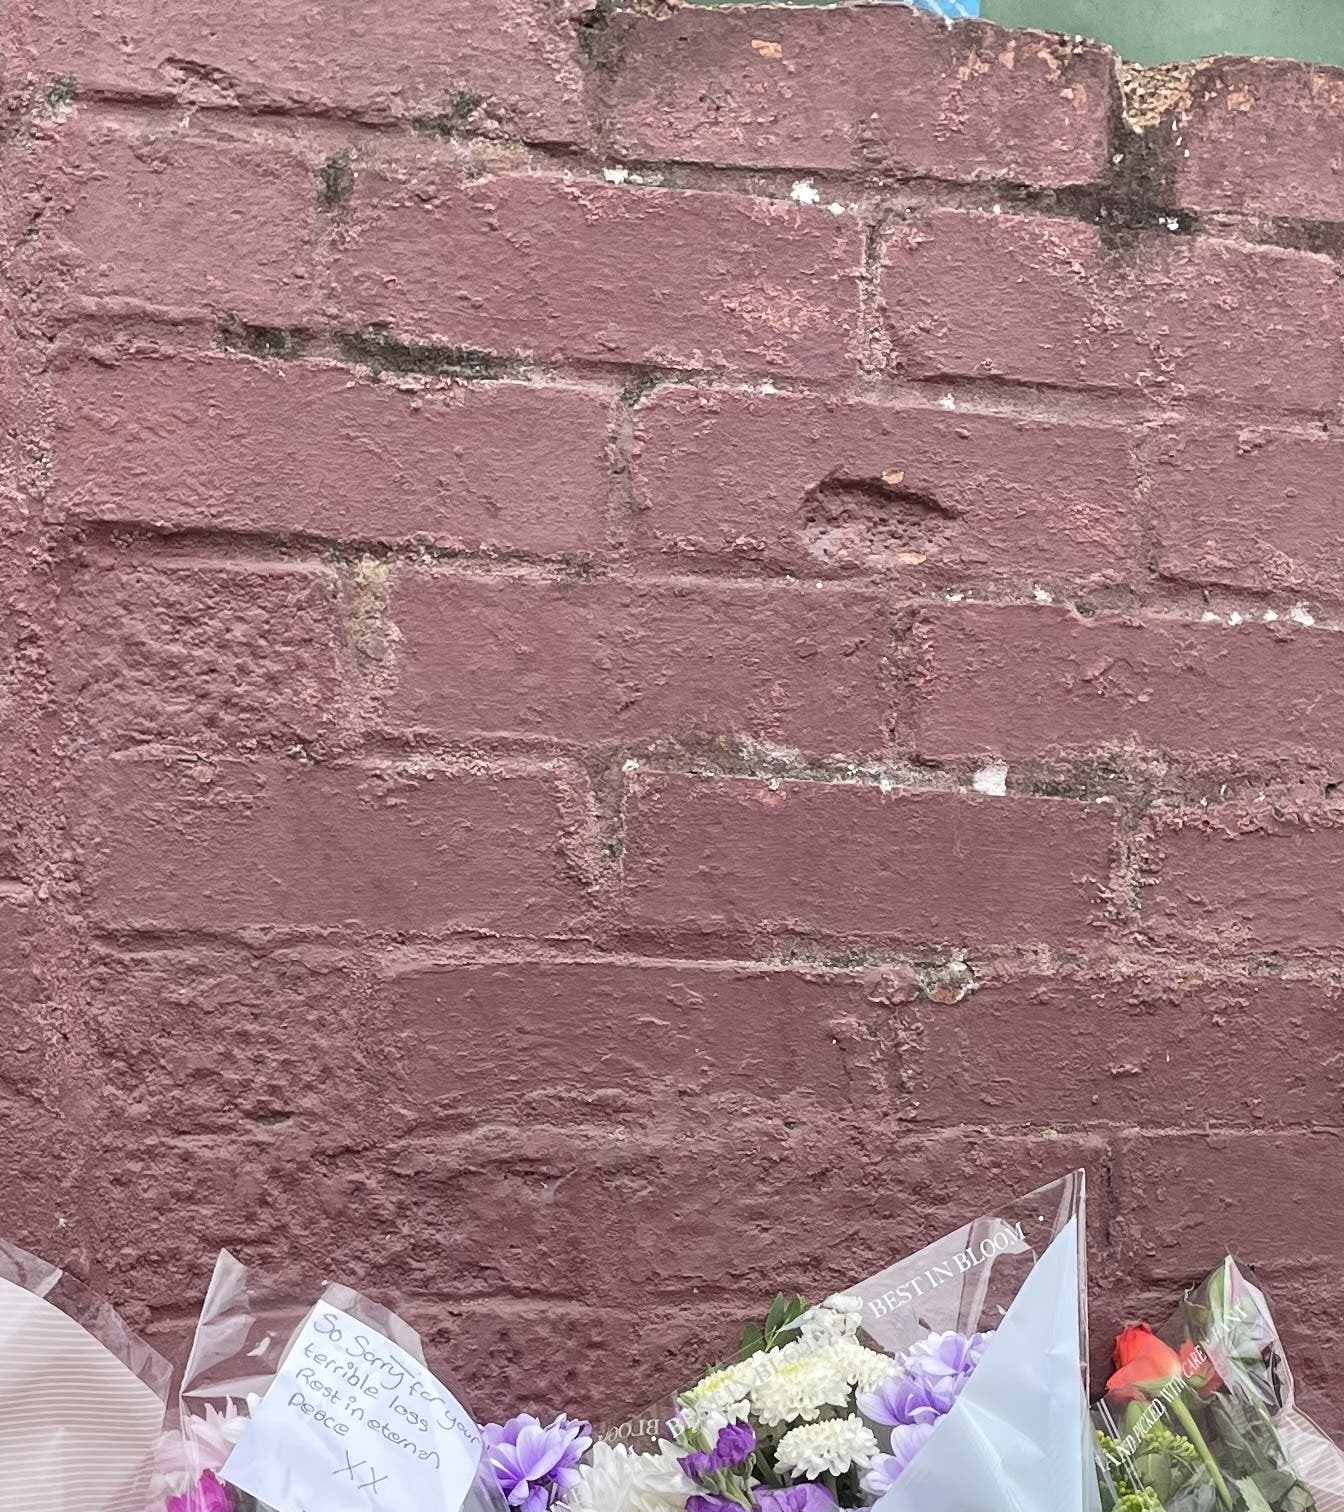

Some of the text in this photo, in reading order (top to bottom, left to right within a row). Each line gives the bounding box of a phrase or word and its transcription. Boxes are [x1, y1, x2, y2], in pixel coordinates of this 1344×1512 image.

[868, 1221, 1027, 1320] BEST IN BLOOM
[295, 1367, 341, 1405] Rest
[344, 1395, 365, 1421] in
[303, 1342, 429, 1432] terrible loss
[313, 1313, 481, 1445] So Sorry for your
[1182, 1343, 1208, 1379] CARE
